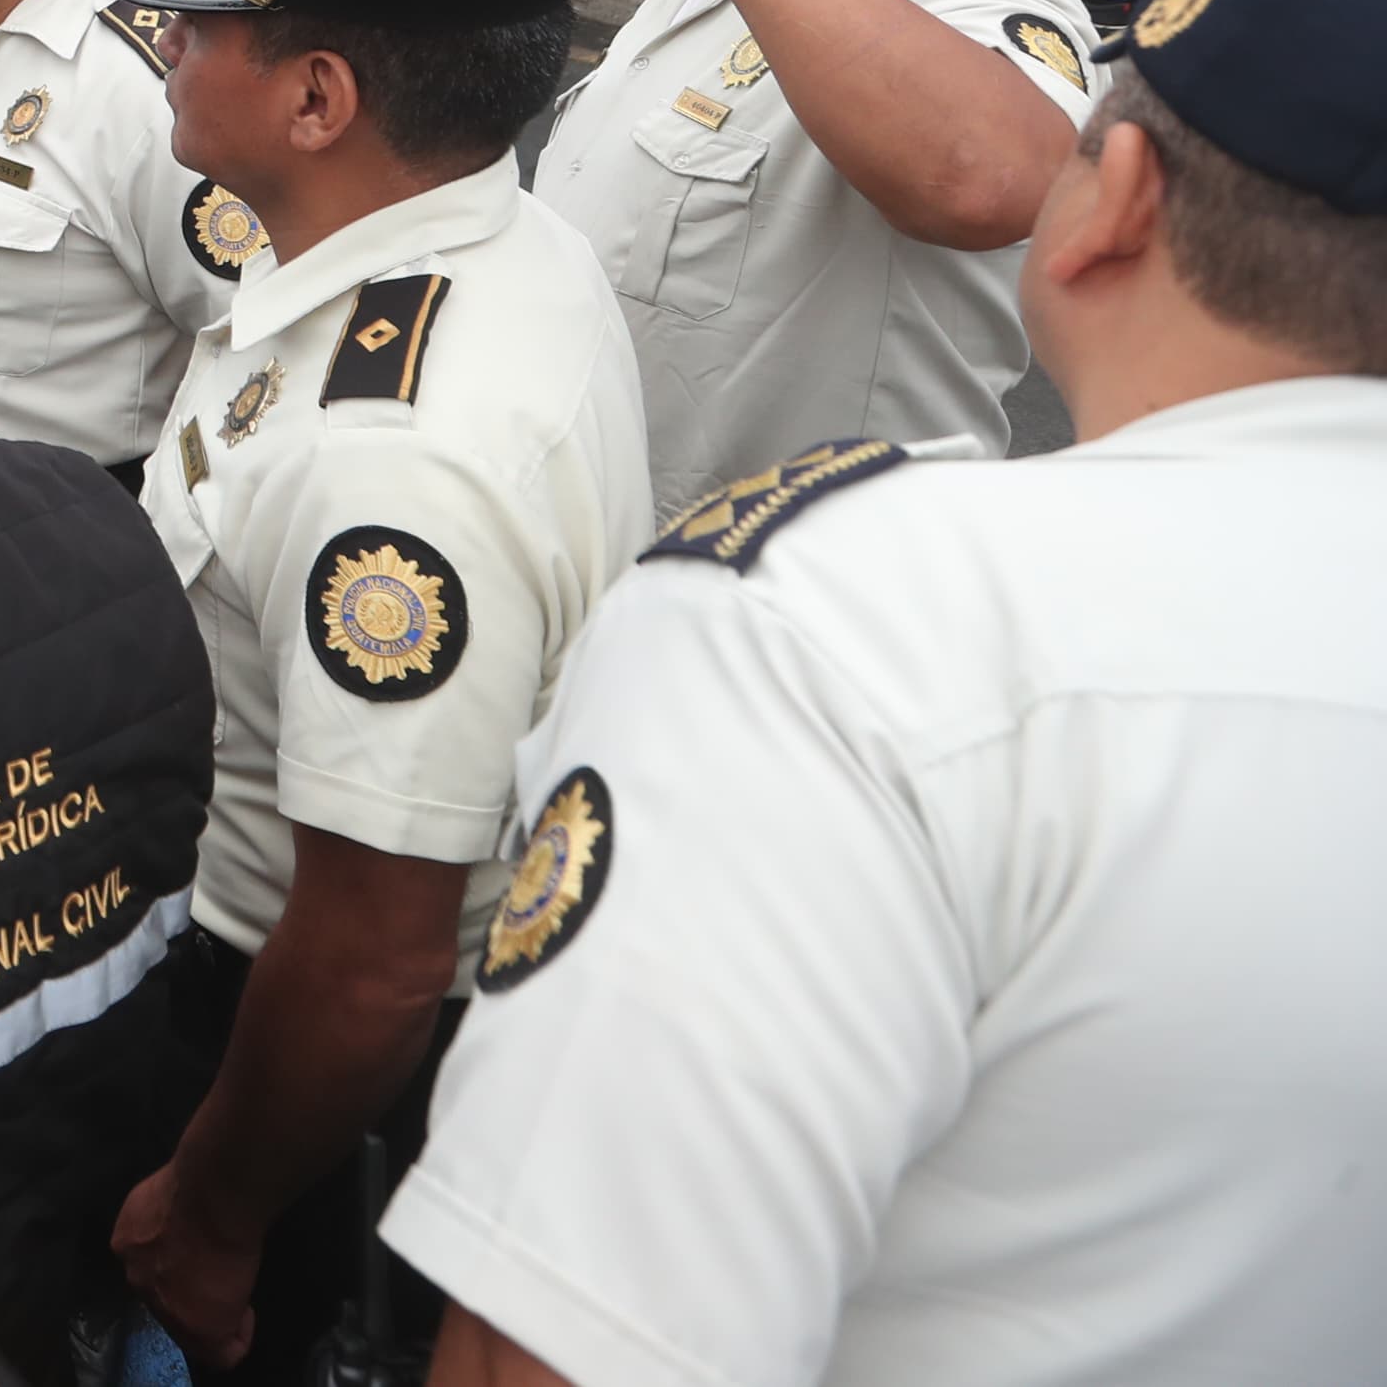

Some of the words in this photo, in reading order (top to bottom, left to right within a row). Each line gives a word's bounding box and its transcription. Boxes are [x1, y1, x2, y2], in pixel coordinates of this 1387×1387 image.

[346, 619, 414, 655] GUATEMALA
[6, 746, 55, 799] DE
[60, 866, 132, 938] CIVIL
